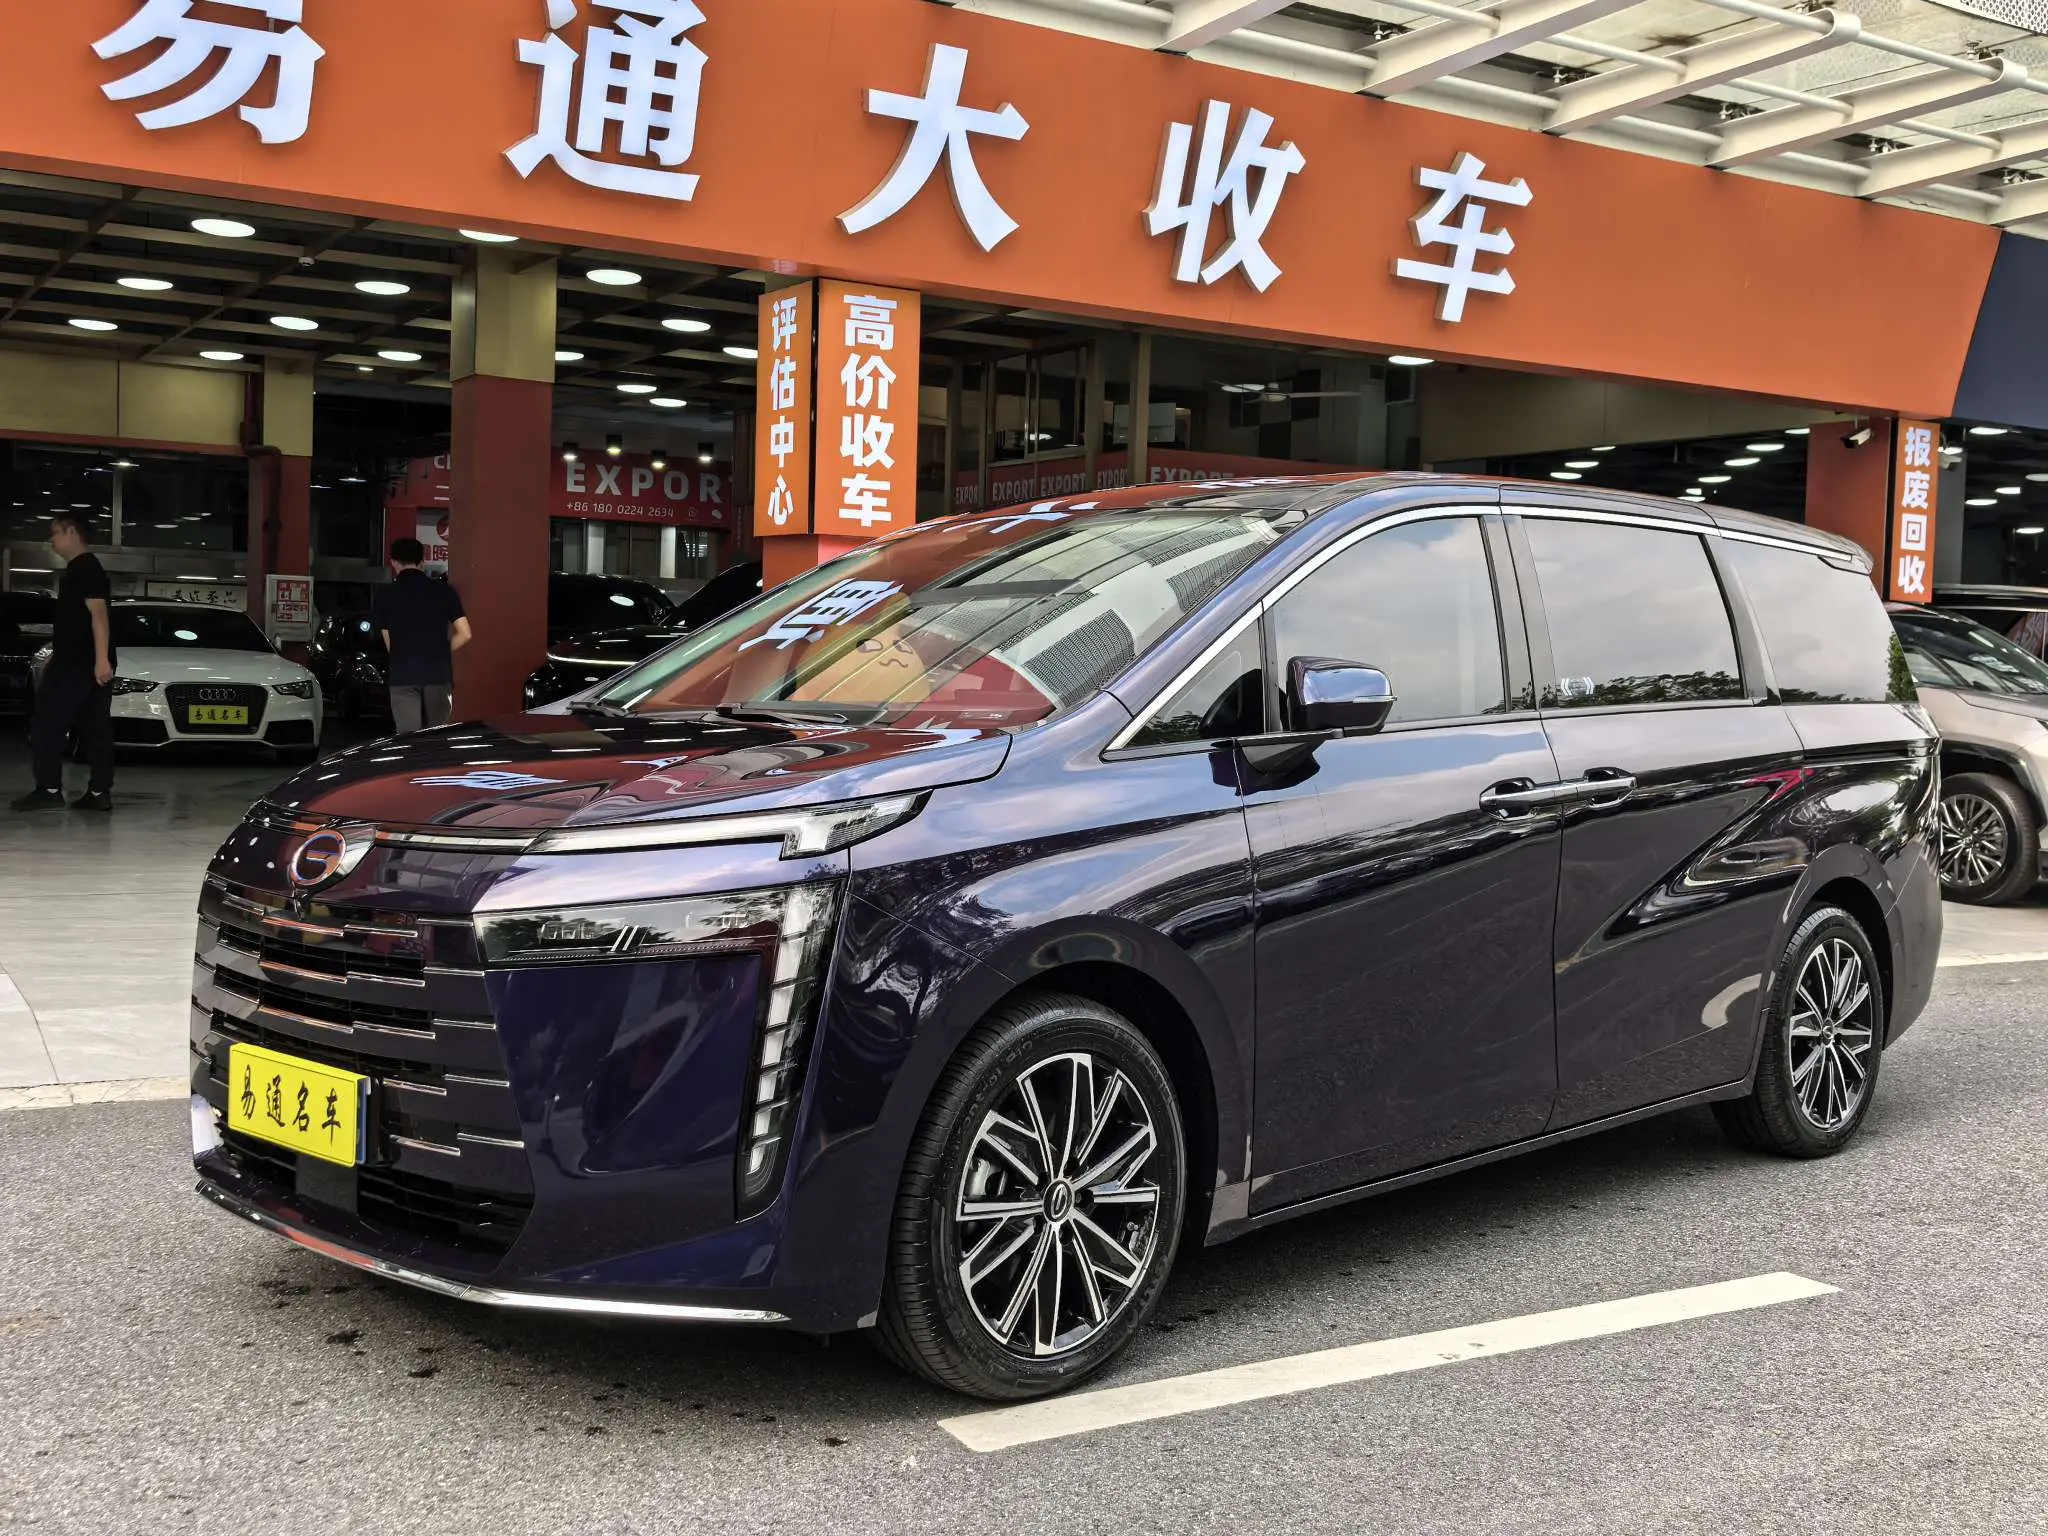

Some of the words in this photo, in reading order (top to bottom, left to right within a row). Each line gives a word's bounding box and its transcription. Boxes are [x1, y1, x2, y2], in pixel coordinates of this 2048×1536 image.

[767, 297, 798, 526] 评估中心
[838, 294, 898, 528] 高价收车
[593, 503, 613, 513] 180
[992, 478, 1035, 501] EXPORT
[1040, 473, 1086, 496] EXPORT
[1898, 426, 1932, 594] 报废回收
